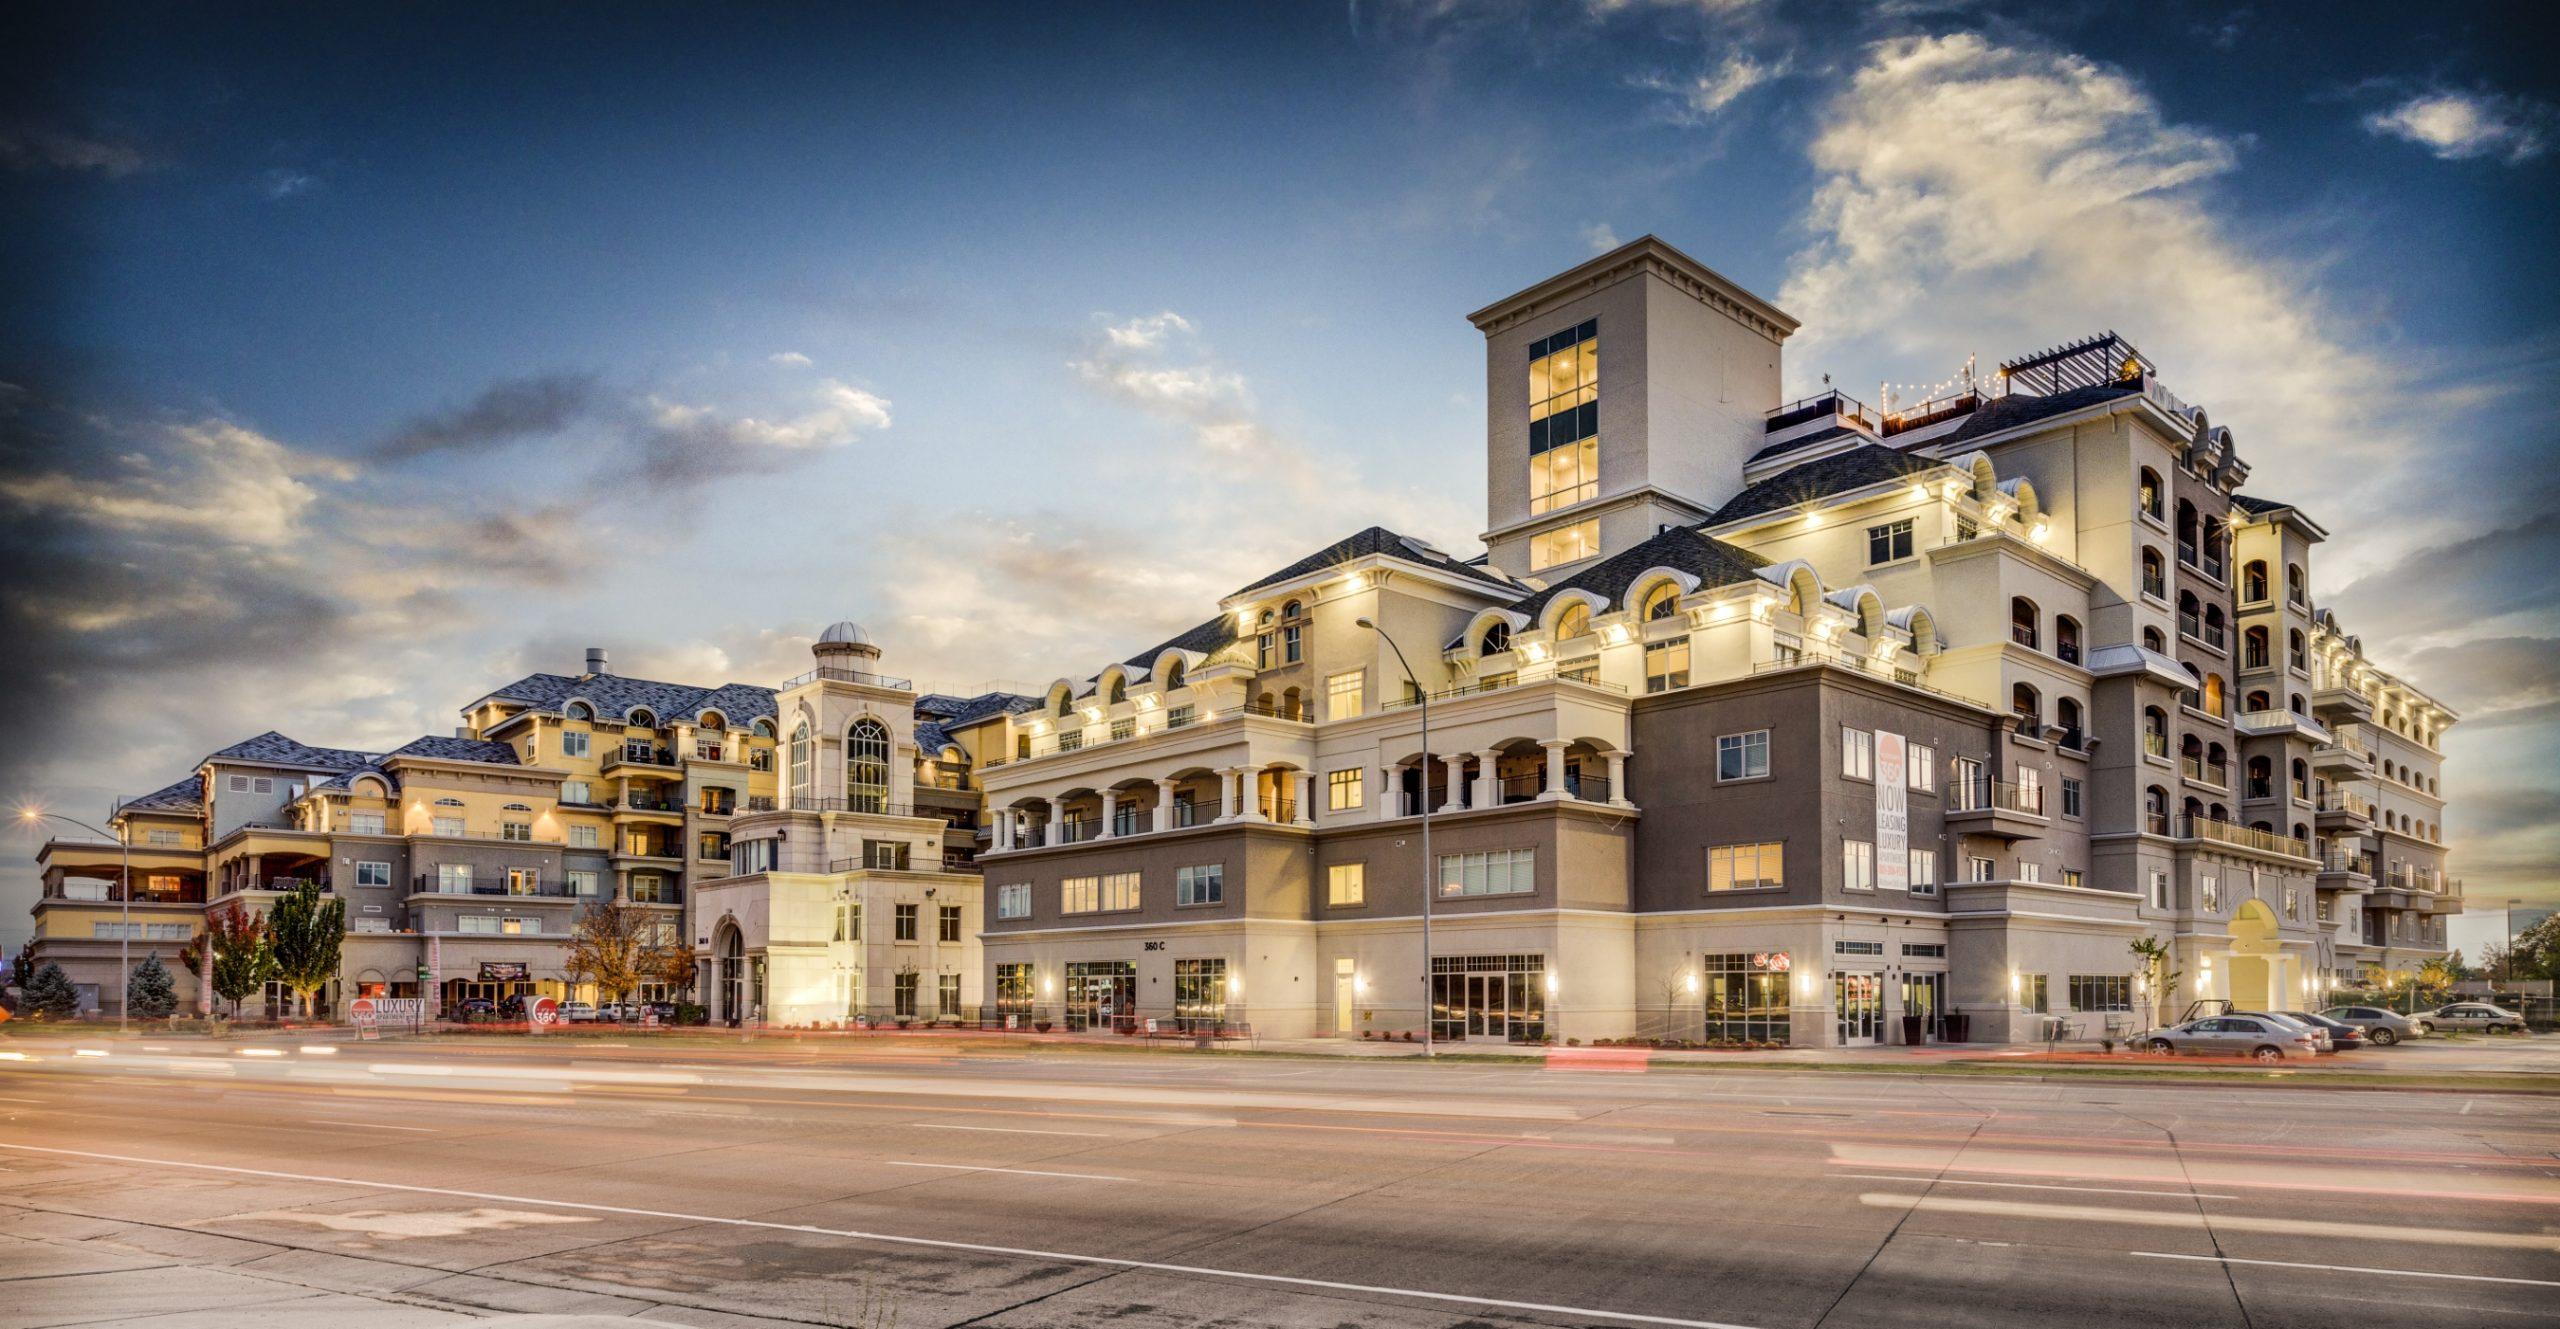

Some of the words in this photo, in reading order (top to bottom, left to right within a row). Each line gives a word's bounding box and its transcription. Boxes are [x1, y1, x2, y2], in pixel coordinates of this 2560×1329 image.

[1877, 784, 1905, 813] NOW
[1878, 814, 1906, 832] LEASING
[1878, 832, 1906, 850] LUXURY
[1144, 941, 1158, 951] 360
[1159, 941, 1165, 951] C
[376, 999, 422, 1014] LUXURY
[536, 1012, 557, 1023] 360
